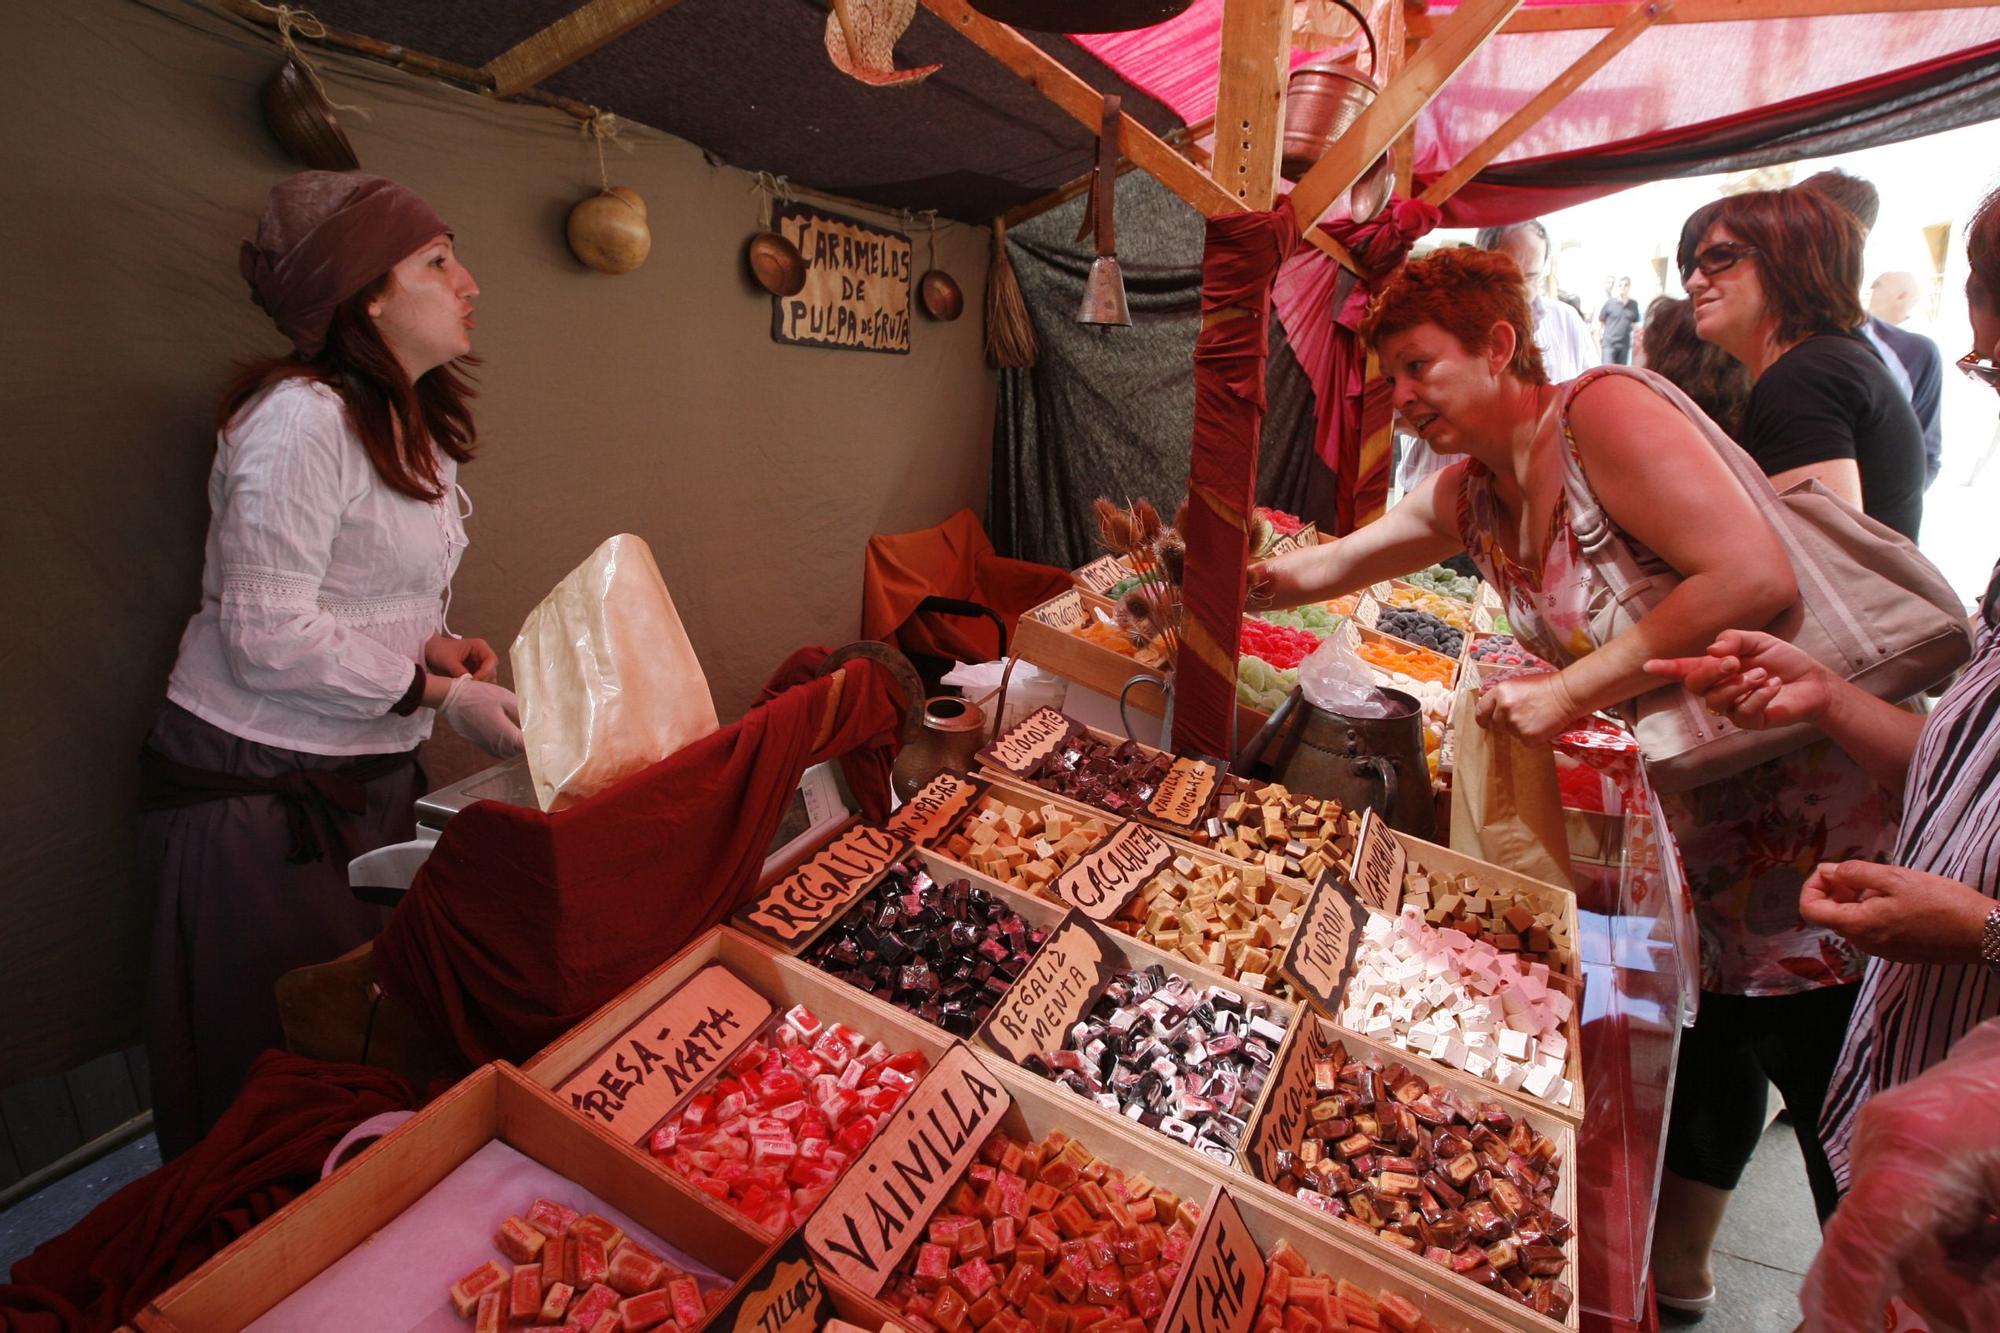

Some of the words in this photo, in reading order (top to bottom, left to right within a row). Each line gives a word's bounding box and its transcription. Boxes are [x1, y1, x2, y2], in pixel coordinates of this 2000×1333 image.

[799, 222, 909, 282] CARAMELOS
[841, 276, 865, 301] DE
[790, 301, 857, 342] PULPA
[861, 318, 873, 337] DE
[873, 307, 909, 346] FRUTA
[1000, 709, 1064, 764] CHOCOLATE
[1155, 769, 1185, 813] VAINILLA
[1177, 769, 1205, 818] CHOCOLATE
[762, 830, 894, 930] REGALIZ
[1072, 824, 1161, 907] CACAHUETE
[1304, 898, 1345, 981] TURRON
[1000, 950, 1066, 1040] REGALIZ
[1031, 966, 1087, 1051] MENTA
[662, 1006, 740, 1097] NATA
[824, 1068, 998, 1273] VAINILLA
